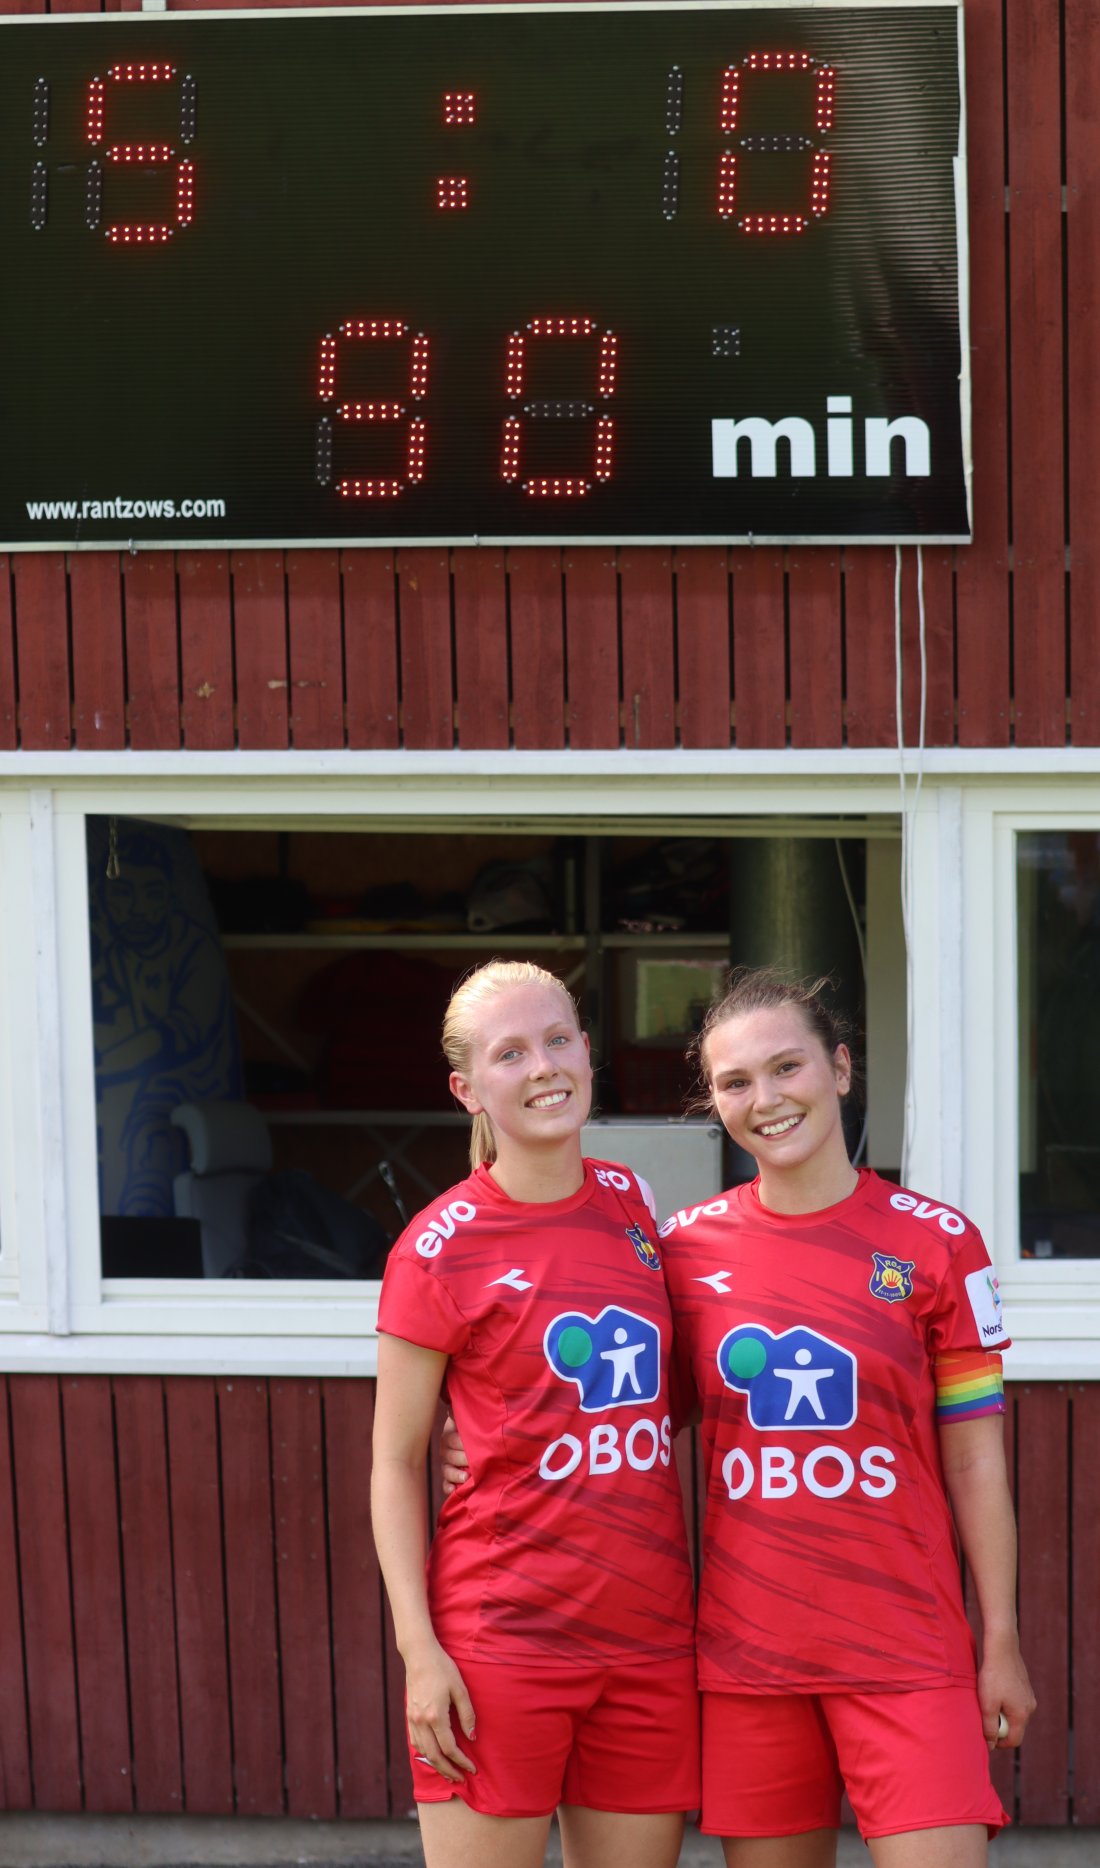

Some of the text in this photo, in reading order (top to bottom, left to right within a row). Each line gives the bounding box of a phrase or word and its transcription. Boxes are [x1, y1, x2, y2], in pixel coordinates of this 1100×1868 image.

[86, 62, 194, 243] 5
[717, 50, 837, 234] 0
[316, 318, 619, 499] 90
[711, 395, 931, 478] min
[26, 498, 226, 521] www.rantzows.com
[415, 1200, 477, 1258] evo
[657, 1200, 729, 1239] evo
[889, 1193, 966, 1236] evo
[538, 1414, 672, 1481] OBOS
[721, 1444, 897, 1501] OBOS
